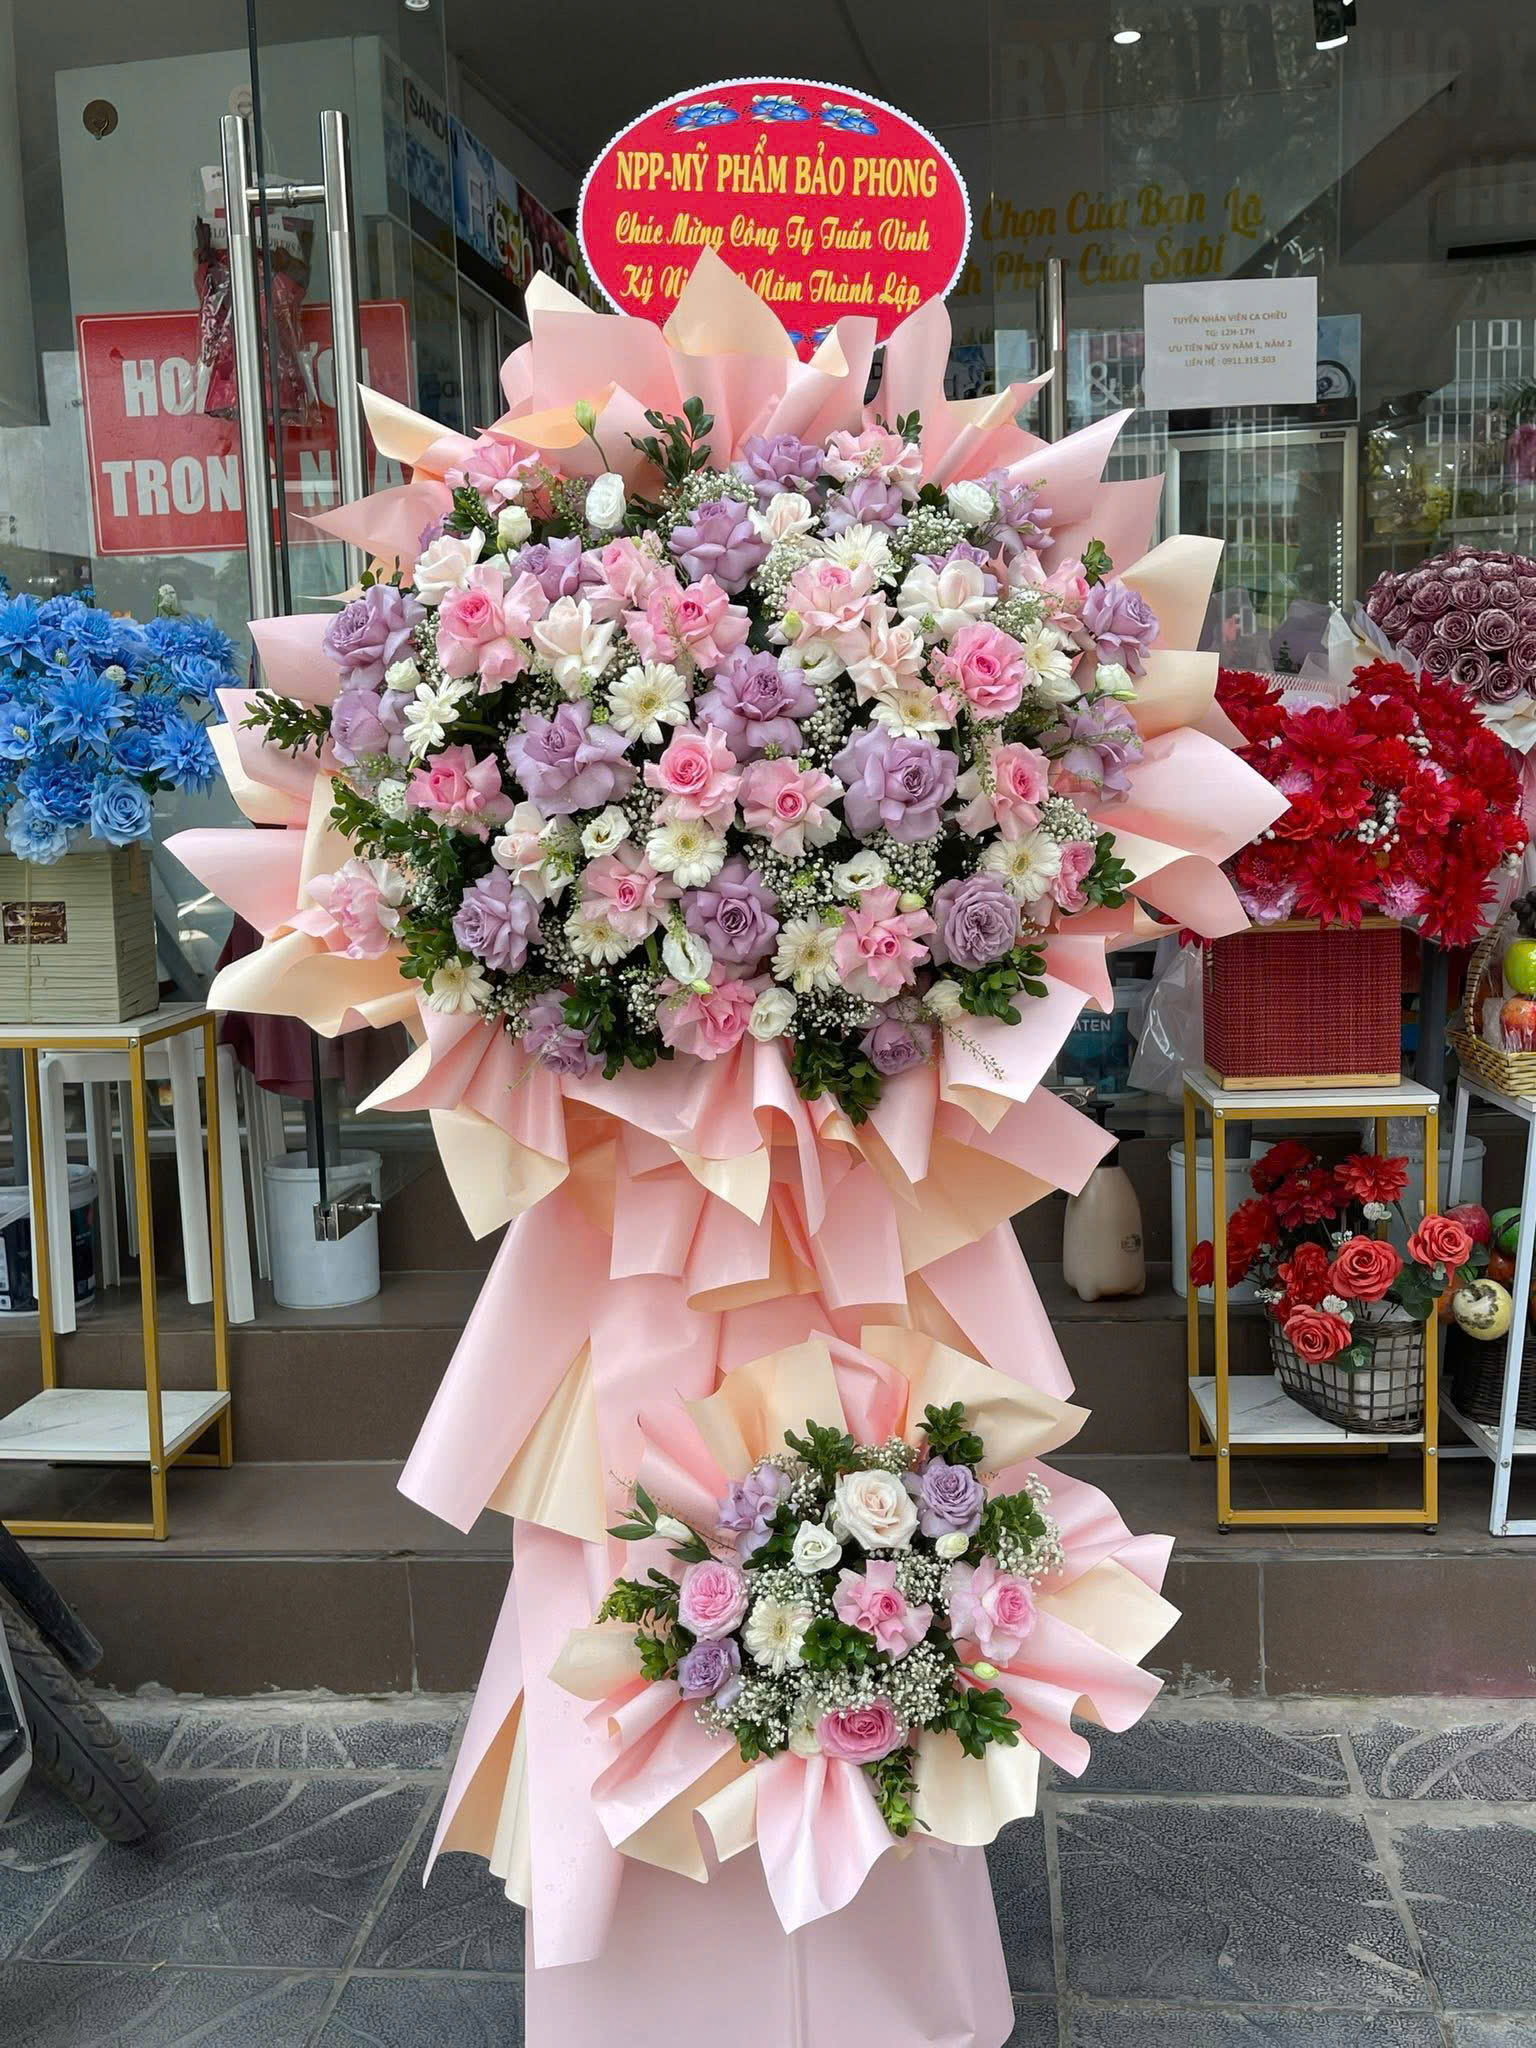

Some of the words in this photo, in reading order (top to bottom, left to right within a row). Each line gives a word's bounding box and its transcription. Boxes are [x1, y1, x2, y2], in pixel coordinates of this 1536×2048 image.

[616, 141, 709, 191] NPP-MỸ
[717, 133, 788, 193] PHẨM
[794, 140, 846, 196] BẢO
[852, 157, 937, 198] PHONG
[467, 168, 534, 286] Fresh
[615, 211, 664, 244] Chúc
[665, 212, 724, 252] Mừng
[730, 213, 780, 255] Công
[786, 215, 814, 256] Ty
[820, 215, 873, 250] Tuấn
[878, 218, 930, 251] Vinh
[751, 268, 803, 301] Năm
[809, 268, 875, 303] Thành
[877, 271, 921, 313] Lập
[1249, 312, 1261, 321] CA
[101, 453, 280, 517] TRON
